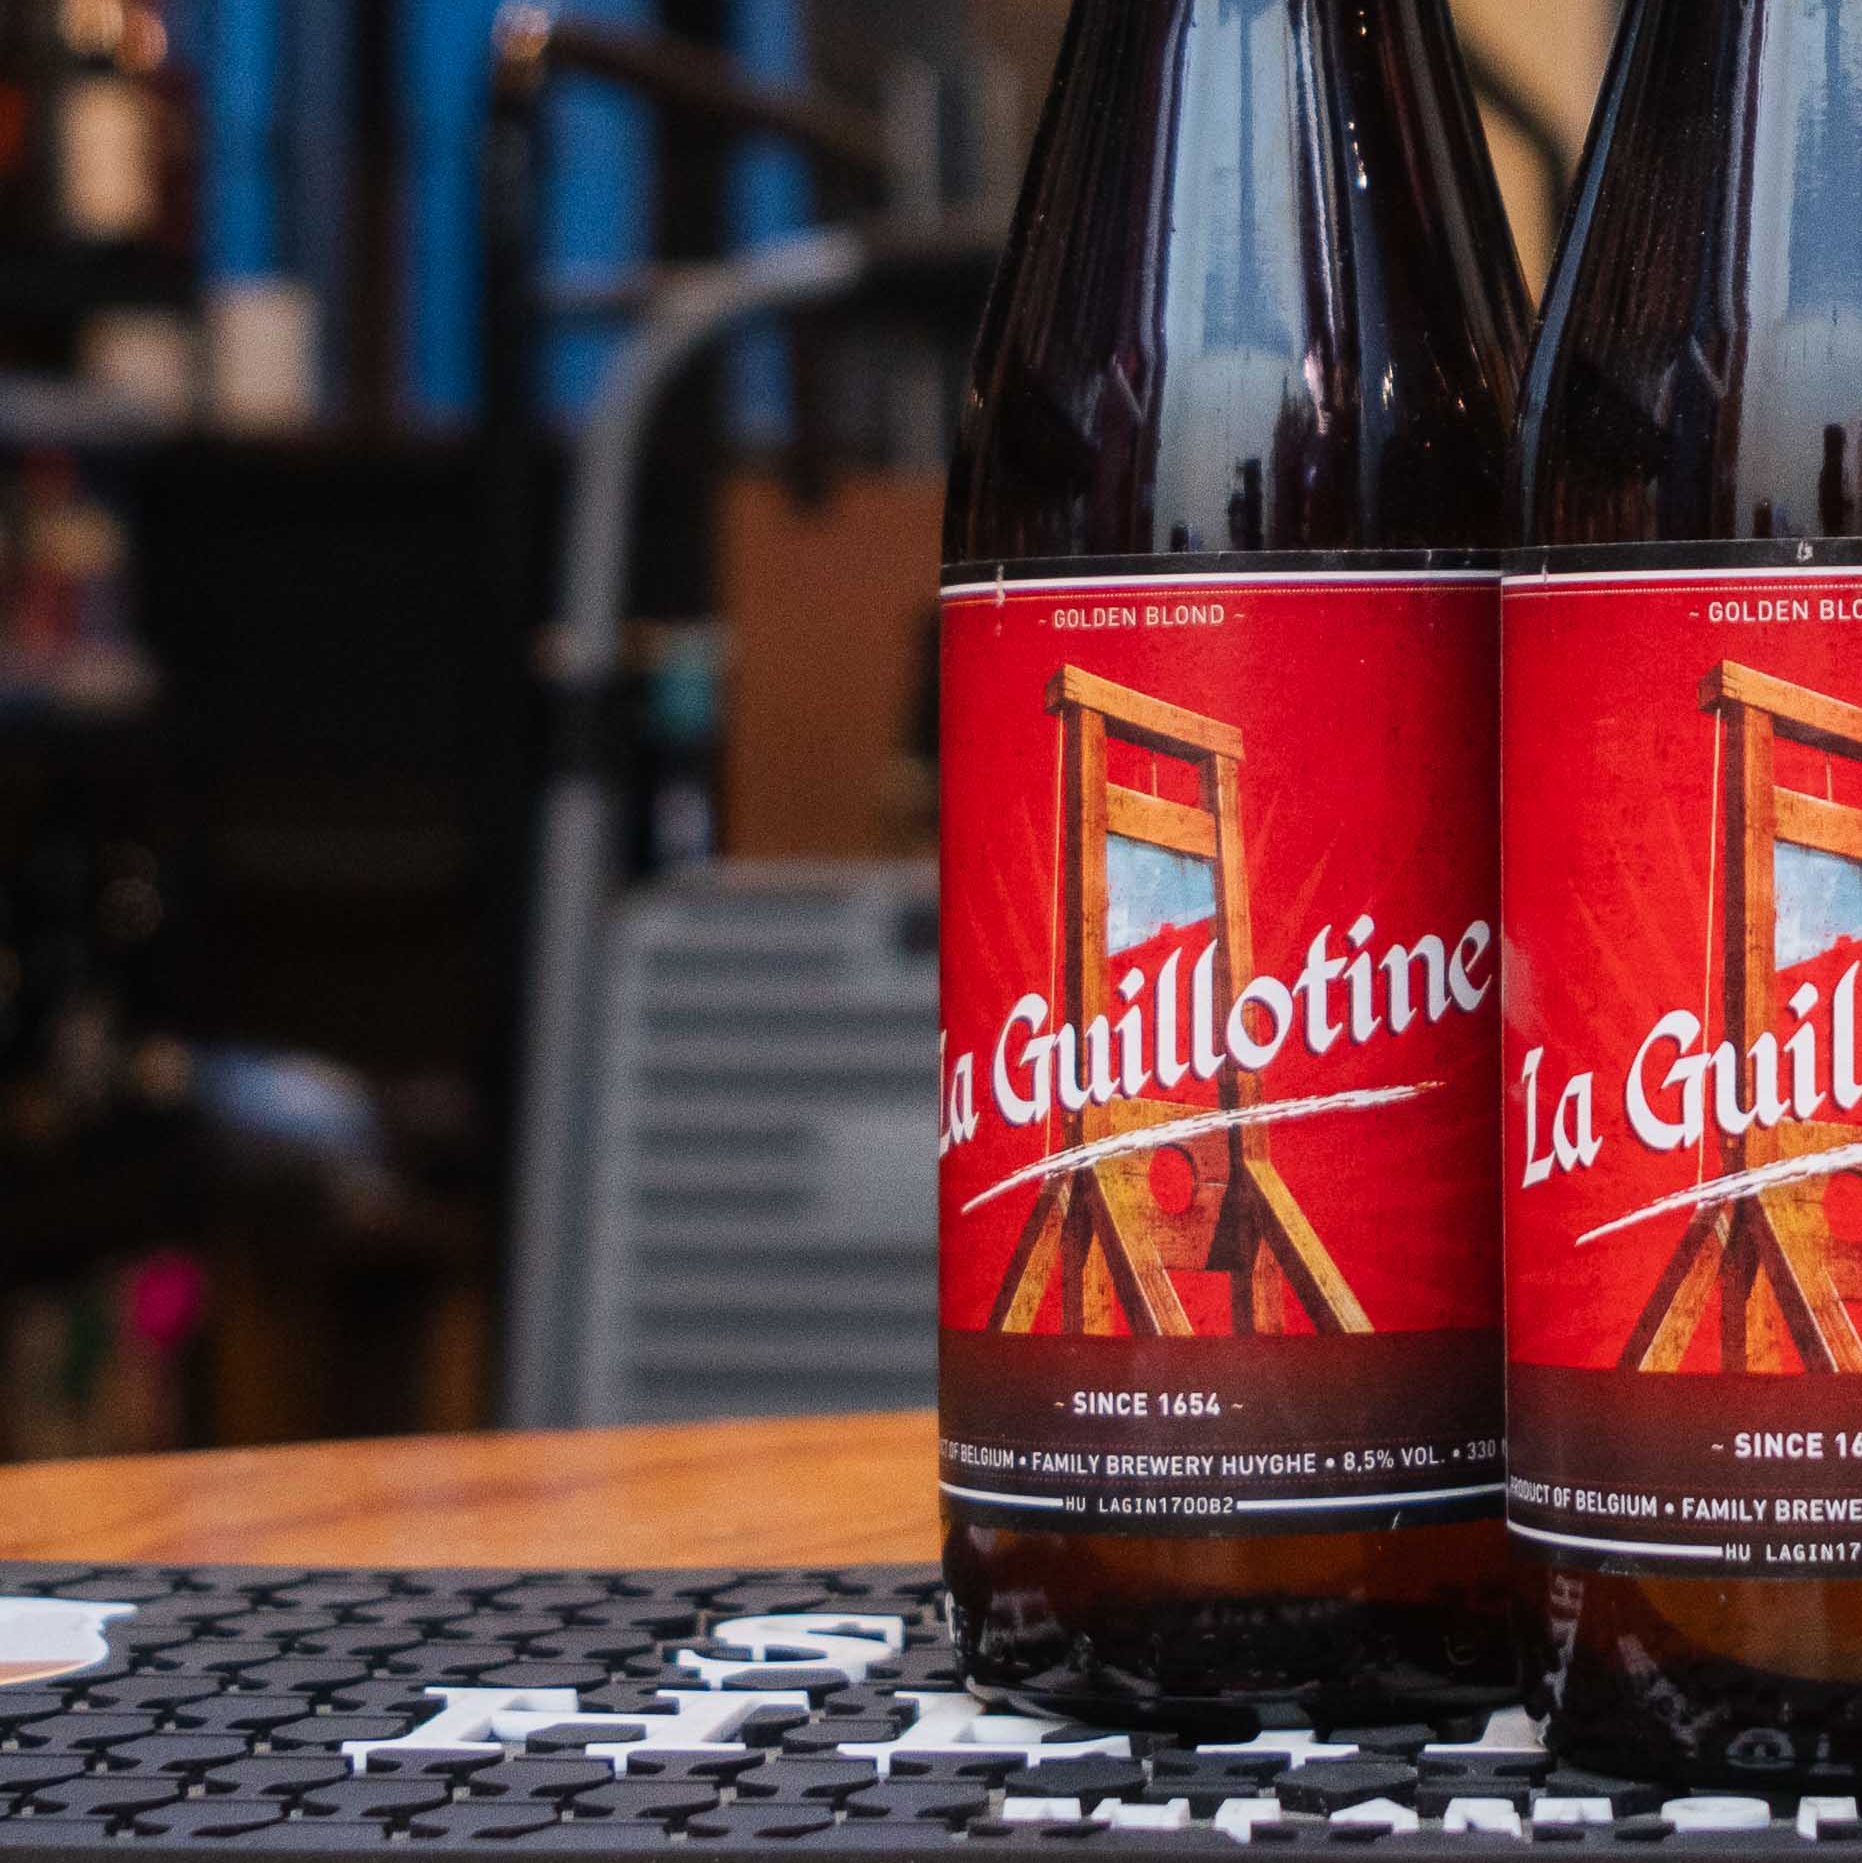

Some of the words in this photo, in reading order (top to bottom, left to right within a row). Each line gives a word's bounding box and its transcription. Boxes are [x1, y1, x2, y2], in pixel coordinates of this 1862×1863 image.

[1053, 606, 1138, 629] GOLDEN
[1145, 604, 1225, 627] BLOND
[1708, 599, 1809, 623] GOLDEN
[992, 913, 1493, 1127] Guillotine
[1520, 1045, 1603, 1190] La
[1073, 1391, 1149, 1417] SINCE
[1159, 1391, 1222, 1417] 1654
[961, 1444, 1014, 1469] BELGIUM
[1032, 1451, 1100, 1475] FAMILY
[1106, 1454, 1214, 1477] BREWERY
[1221, 1452, 1317, 1476] HUYGHE
[1400, 1445, 1446, 1467] VOL.
[1467, 1438, 1496, 1461] 330
[1734, 1432, 1824, 1459] SINCE
[1065, 1496, 1087, 1511] HU
[1553, 1486, 1571, 1509] OF
[1575, 1488, 1657, 1517] BELGIUM
[1682, 1497, 1767, 1522] FAMILY
[1725, 1542, 1751, 1563] HU
